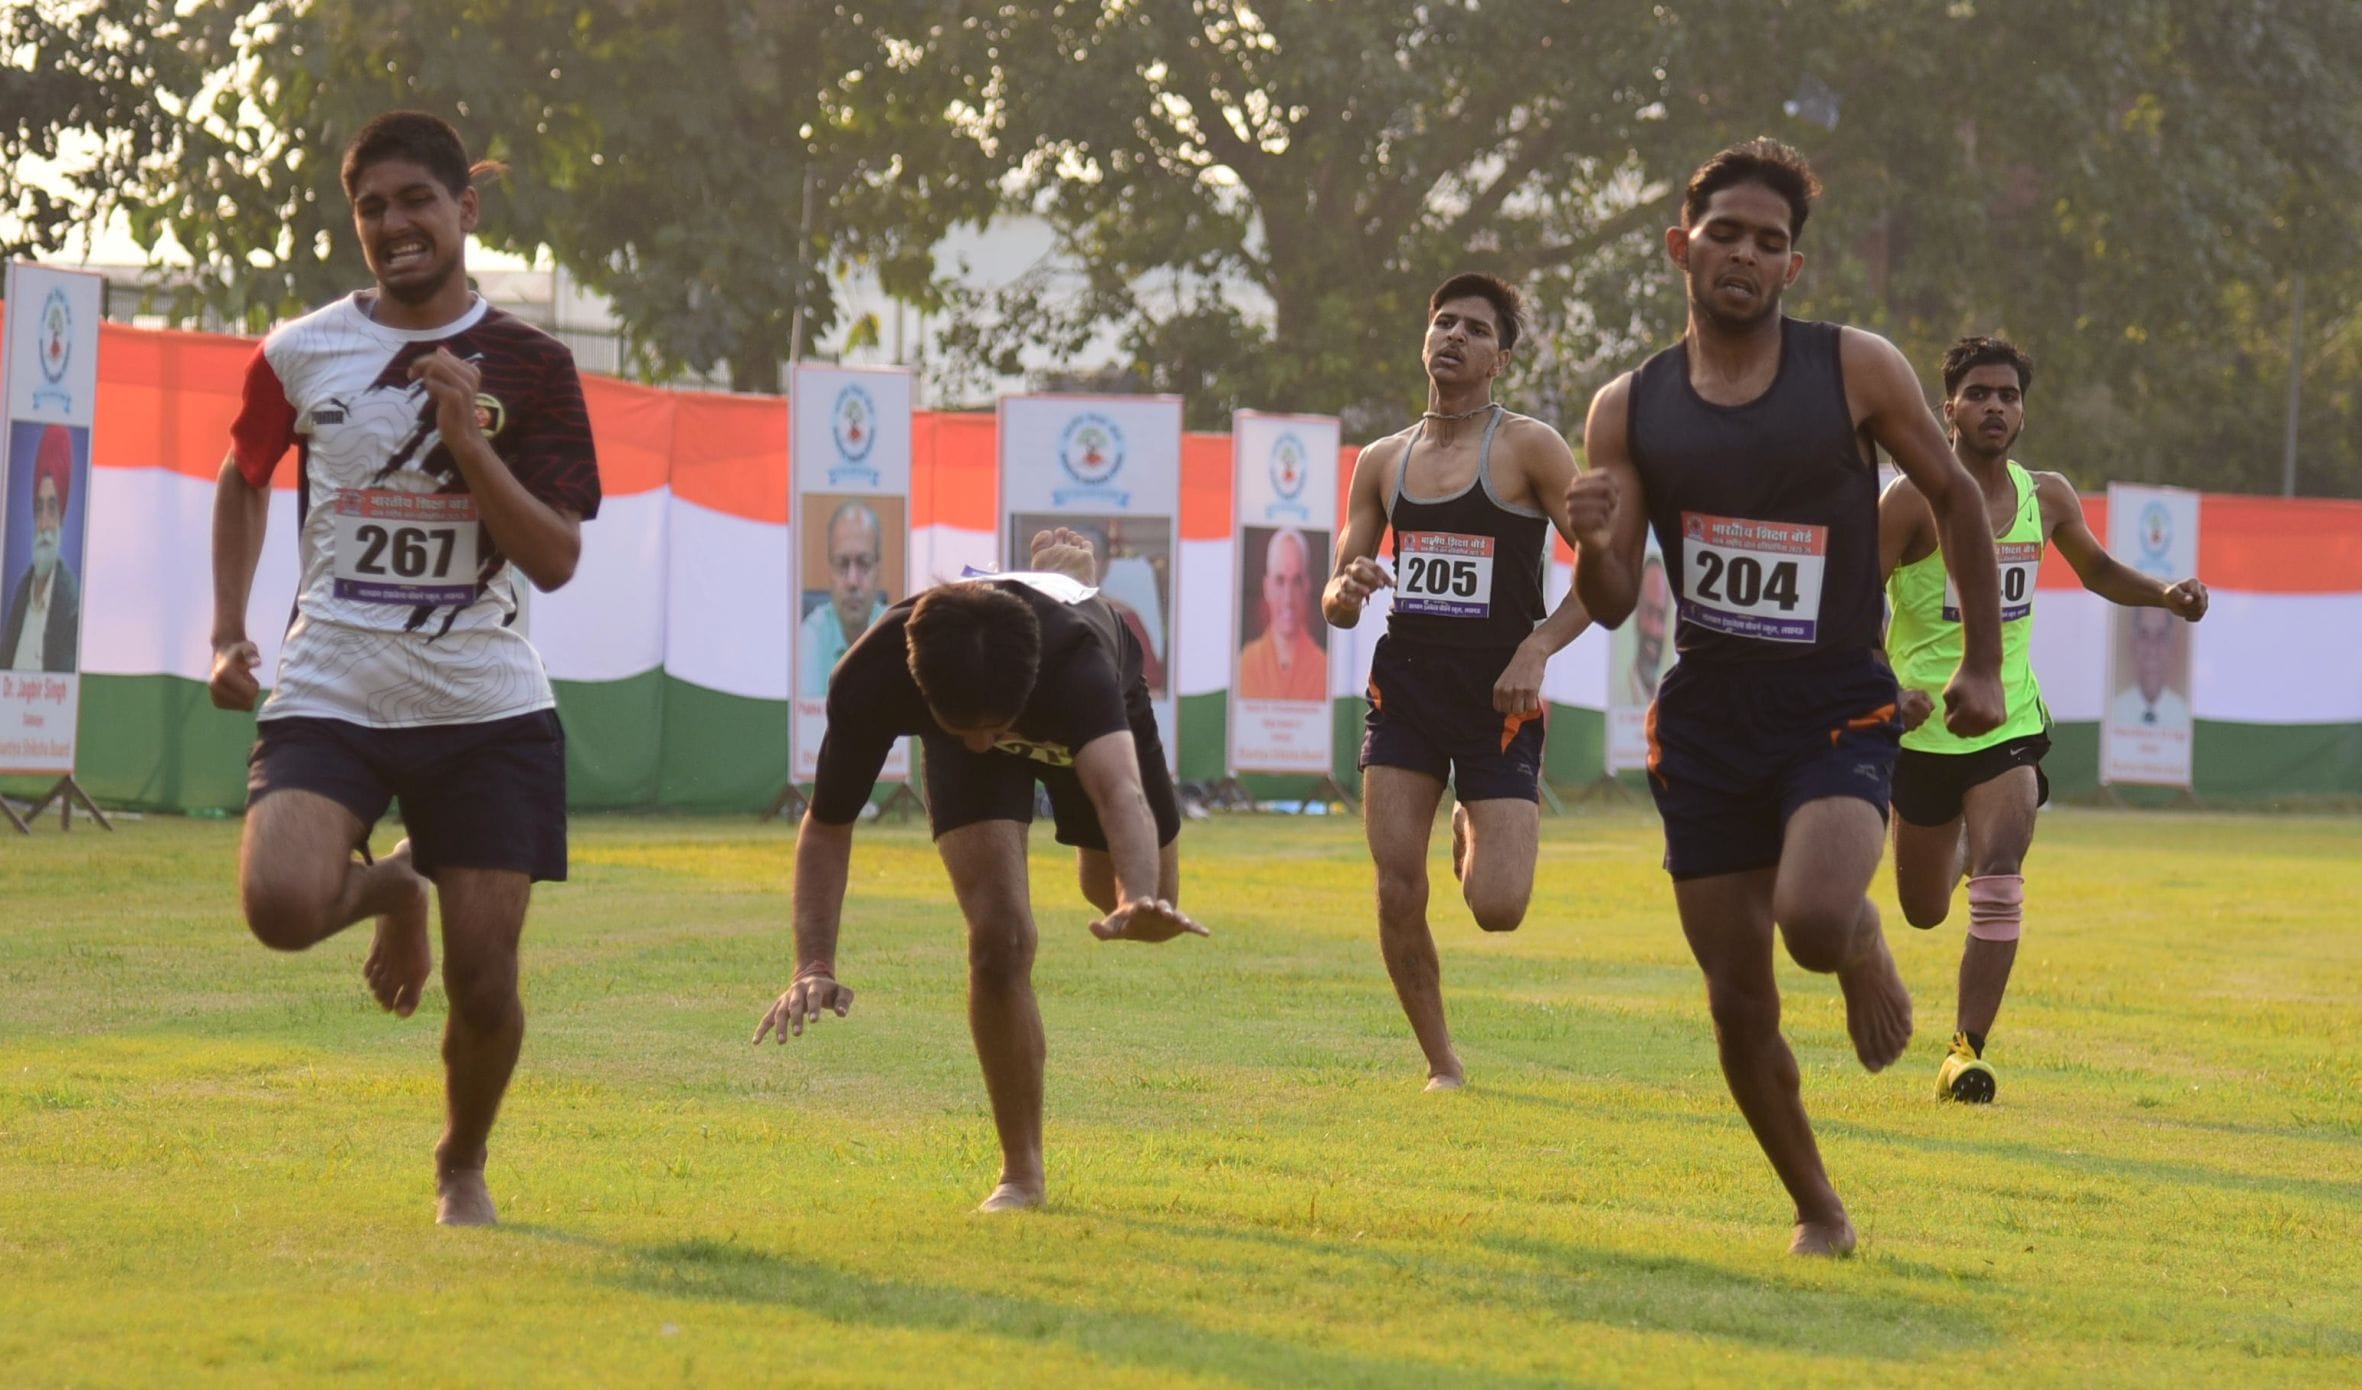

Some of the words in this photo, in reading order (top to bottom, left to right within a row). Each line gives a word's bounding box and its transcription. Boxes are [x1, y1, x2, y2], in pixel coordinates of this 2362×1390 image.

[312, 410, 344, 425] PUMA
[1712, 523, 1753, 538] भारतीय
[1756, 527, 1788, 541] शिक्षा
[1791, 530, 1813, 543] बोर्ड
[355, 524, 456, 578] 267
[1406, 557, 1478, 597] 205
[1696, 550, 1799, 611] 204
[44, 677, 66, 705] Singh
